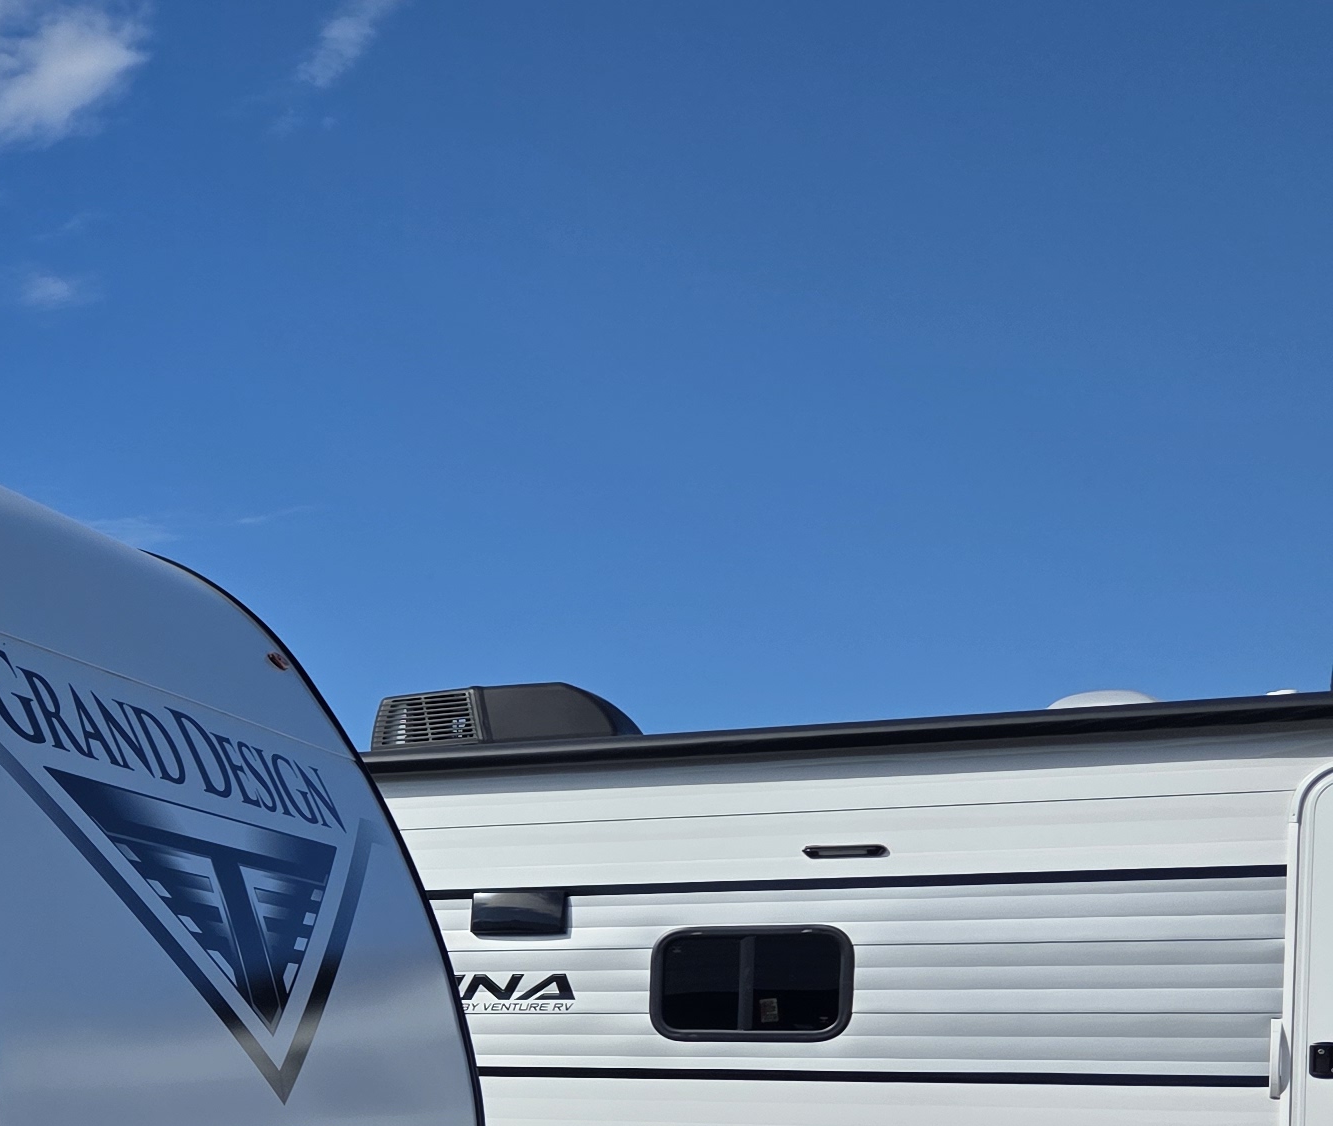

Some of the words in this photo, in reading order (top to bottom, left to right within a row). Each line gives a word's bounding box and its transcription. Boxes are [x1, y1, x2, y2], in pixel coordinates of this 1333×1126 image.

[164, 706, 347, 833] DESIGN
[483, 1002, 550, 1012] VENTURE
[552, 1002, 574, 1012] RV
